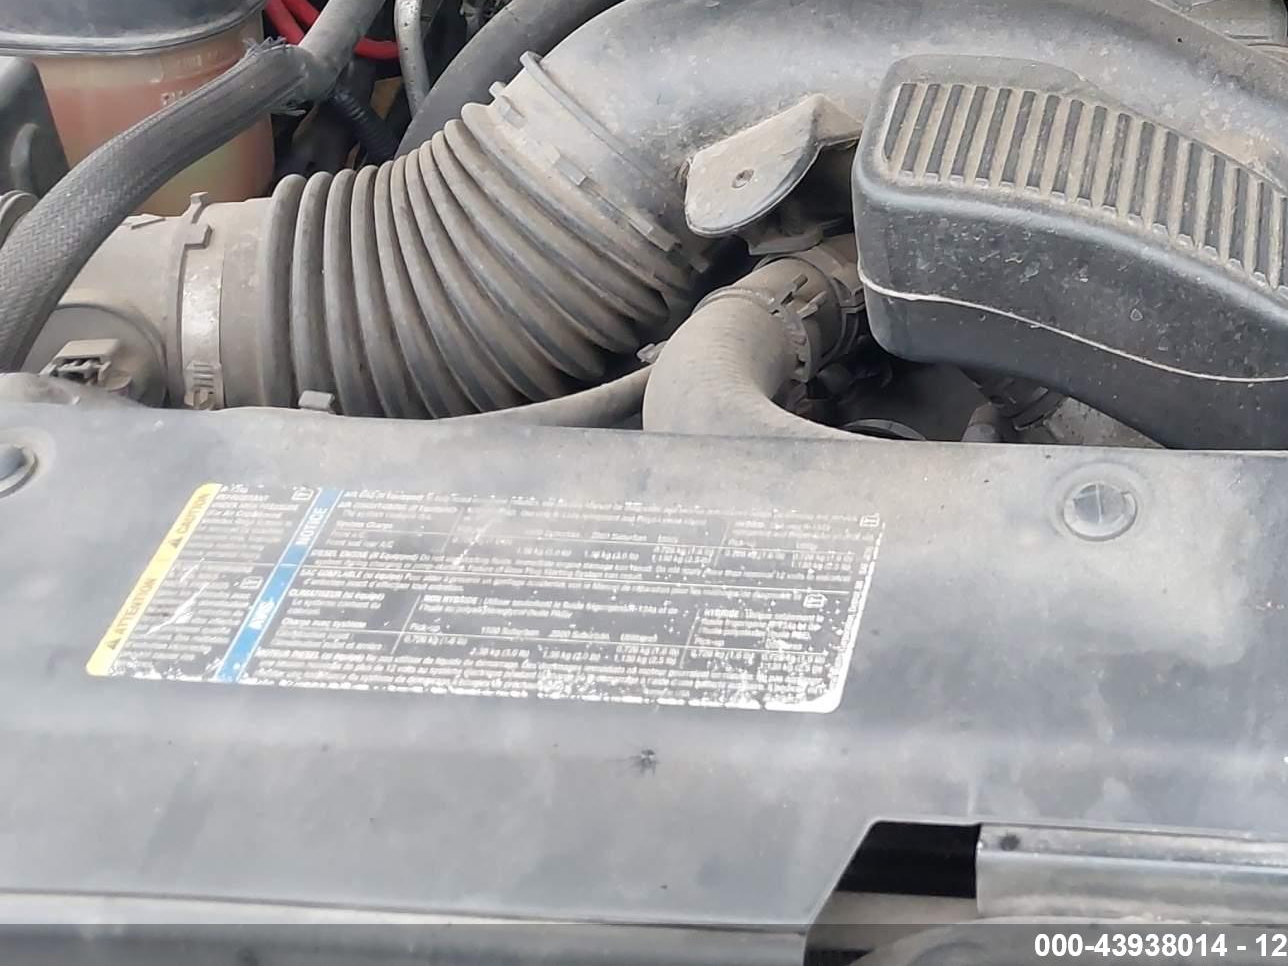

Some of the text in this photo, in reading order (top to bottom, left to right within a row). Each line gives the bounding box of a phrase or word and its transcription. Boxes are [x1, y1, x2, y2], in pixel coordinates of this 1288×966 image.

[178, 492, 211, 536] CAUTION
[295, 506, 327, 546] NOTICE
[115, 577, 156, 636] ATTENTION
